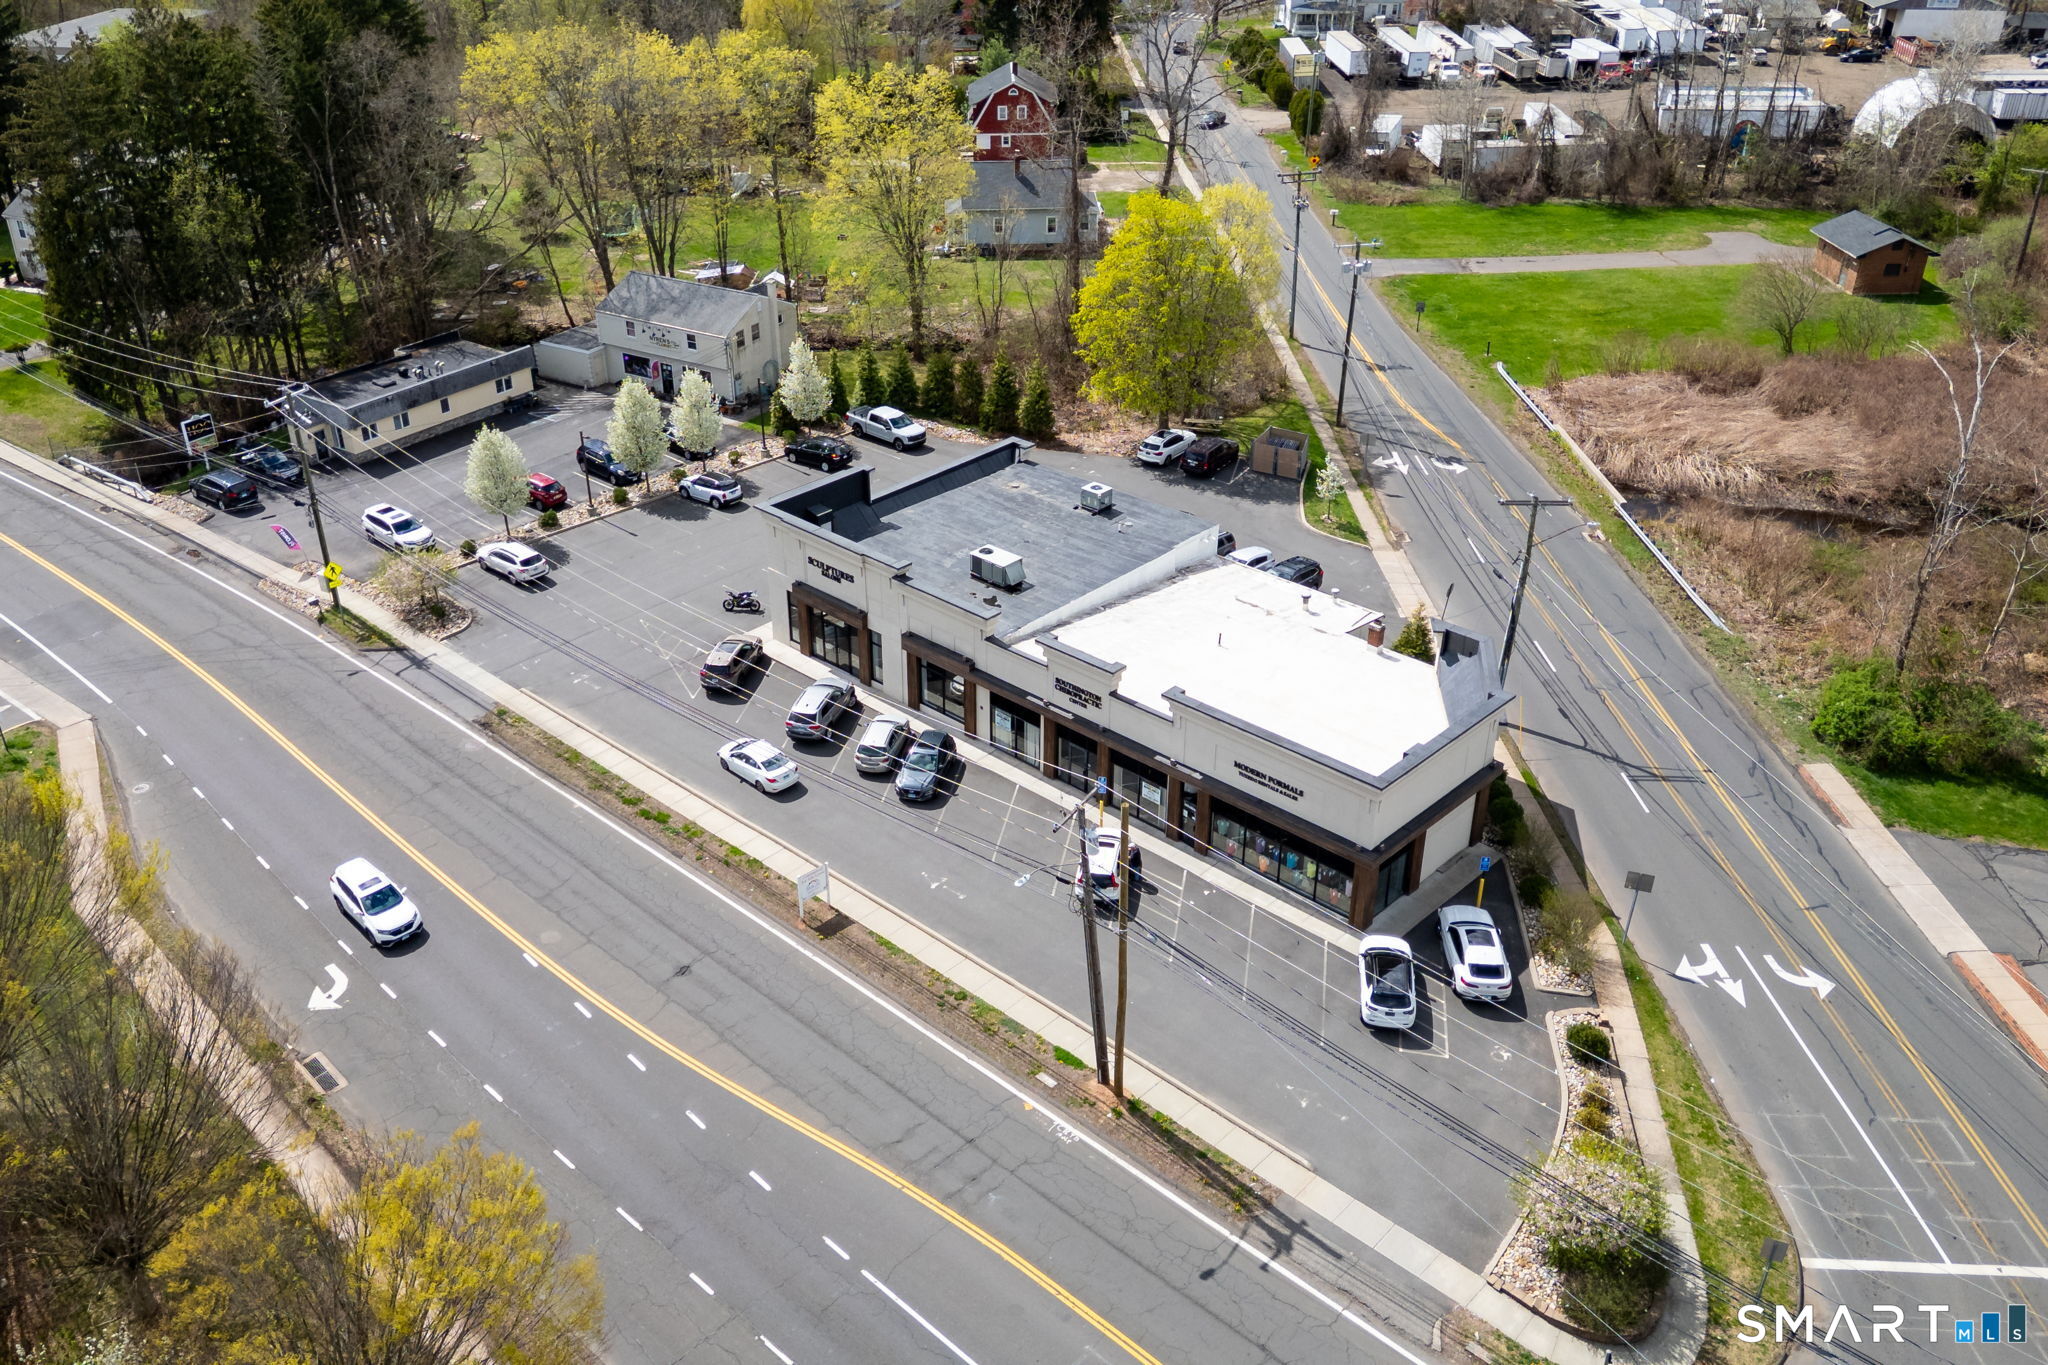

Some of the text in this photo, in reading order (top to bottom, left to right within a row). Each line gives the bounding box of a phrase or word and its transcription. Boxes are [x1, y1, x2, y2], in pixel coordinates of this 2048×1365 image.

[807, 556, 855, 584] SCULPTURES
[1054, 684, 1103, 709] CHIROPRACTIC
[1055, 677, 1102, 702] SOUTHINGTON
[1068, 697, 1088, 709] CENTER
[1233, 760, 1305, 797] MODERN FORMALS
